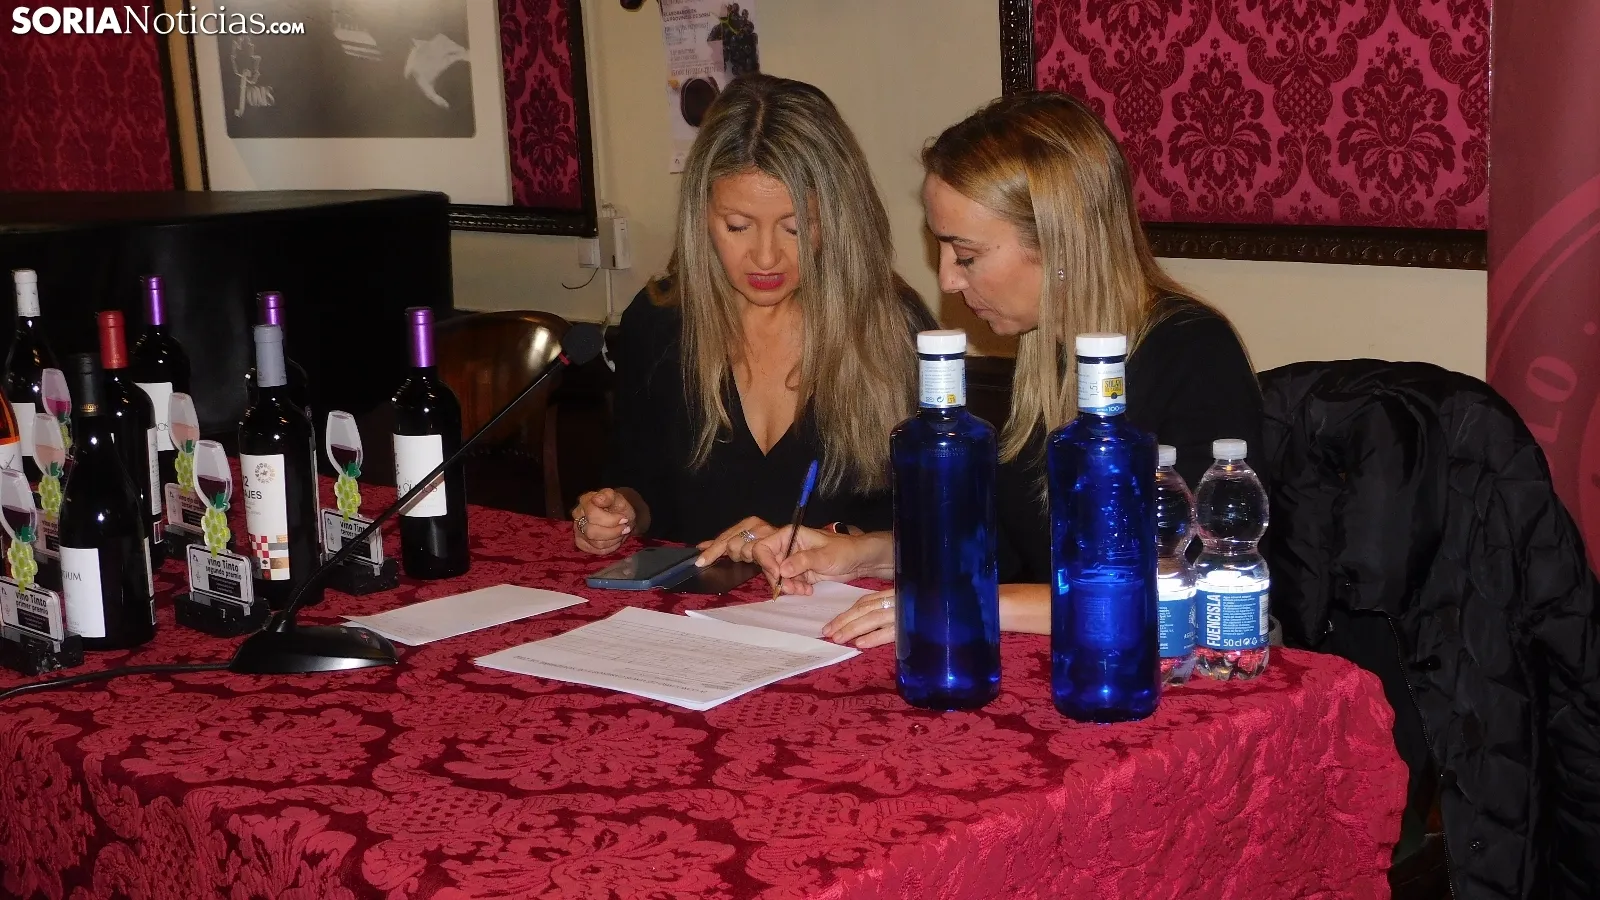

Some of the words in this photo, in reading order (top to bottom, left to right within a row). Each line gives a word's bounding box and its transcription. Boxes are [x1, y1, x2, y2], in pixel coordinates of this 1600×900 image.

[354, 523, 366, 533] Tint
[222, 560, 239, 572] Tinto
[206, 566, 225, 575] segundo
[225, 570, 242, 580] premio
[30, 594, 47, 607] Tinto
[16, 601, 31, 610] primer
[32, 605, 48, 615] premio
[1207, 595, 1221, 646] FUENCISLA
[1223, 639, 1234, 647] 50
[1235, 639, 1242, 647] cl
